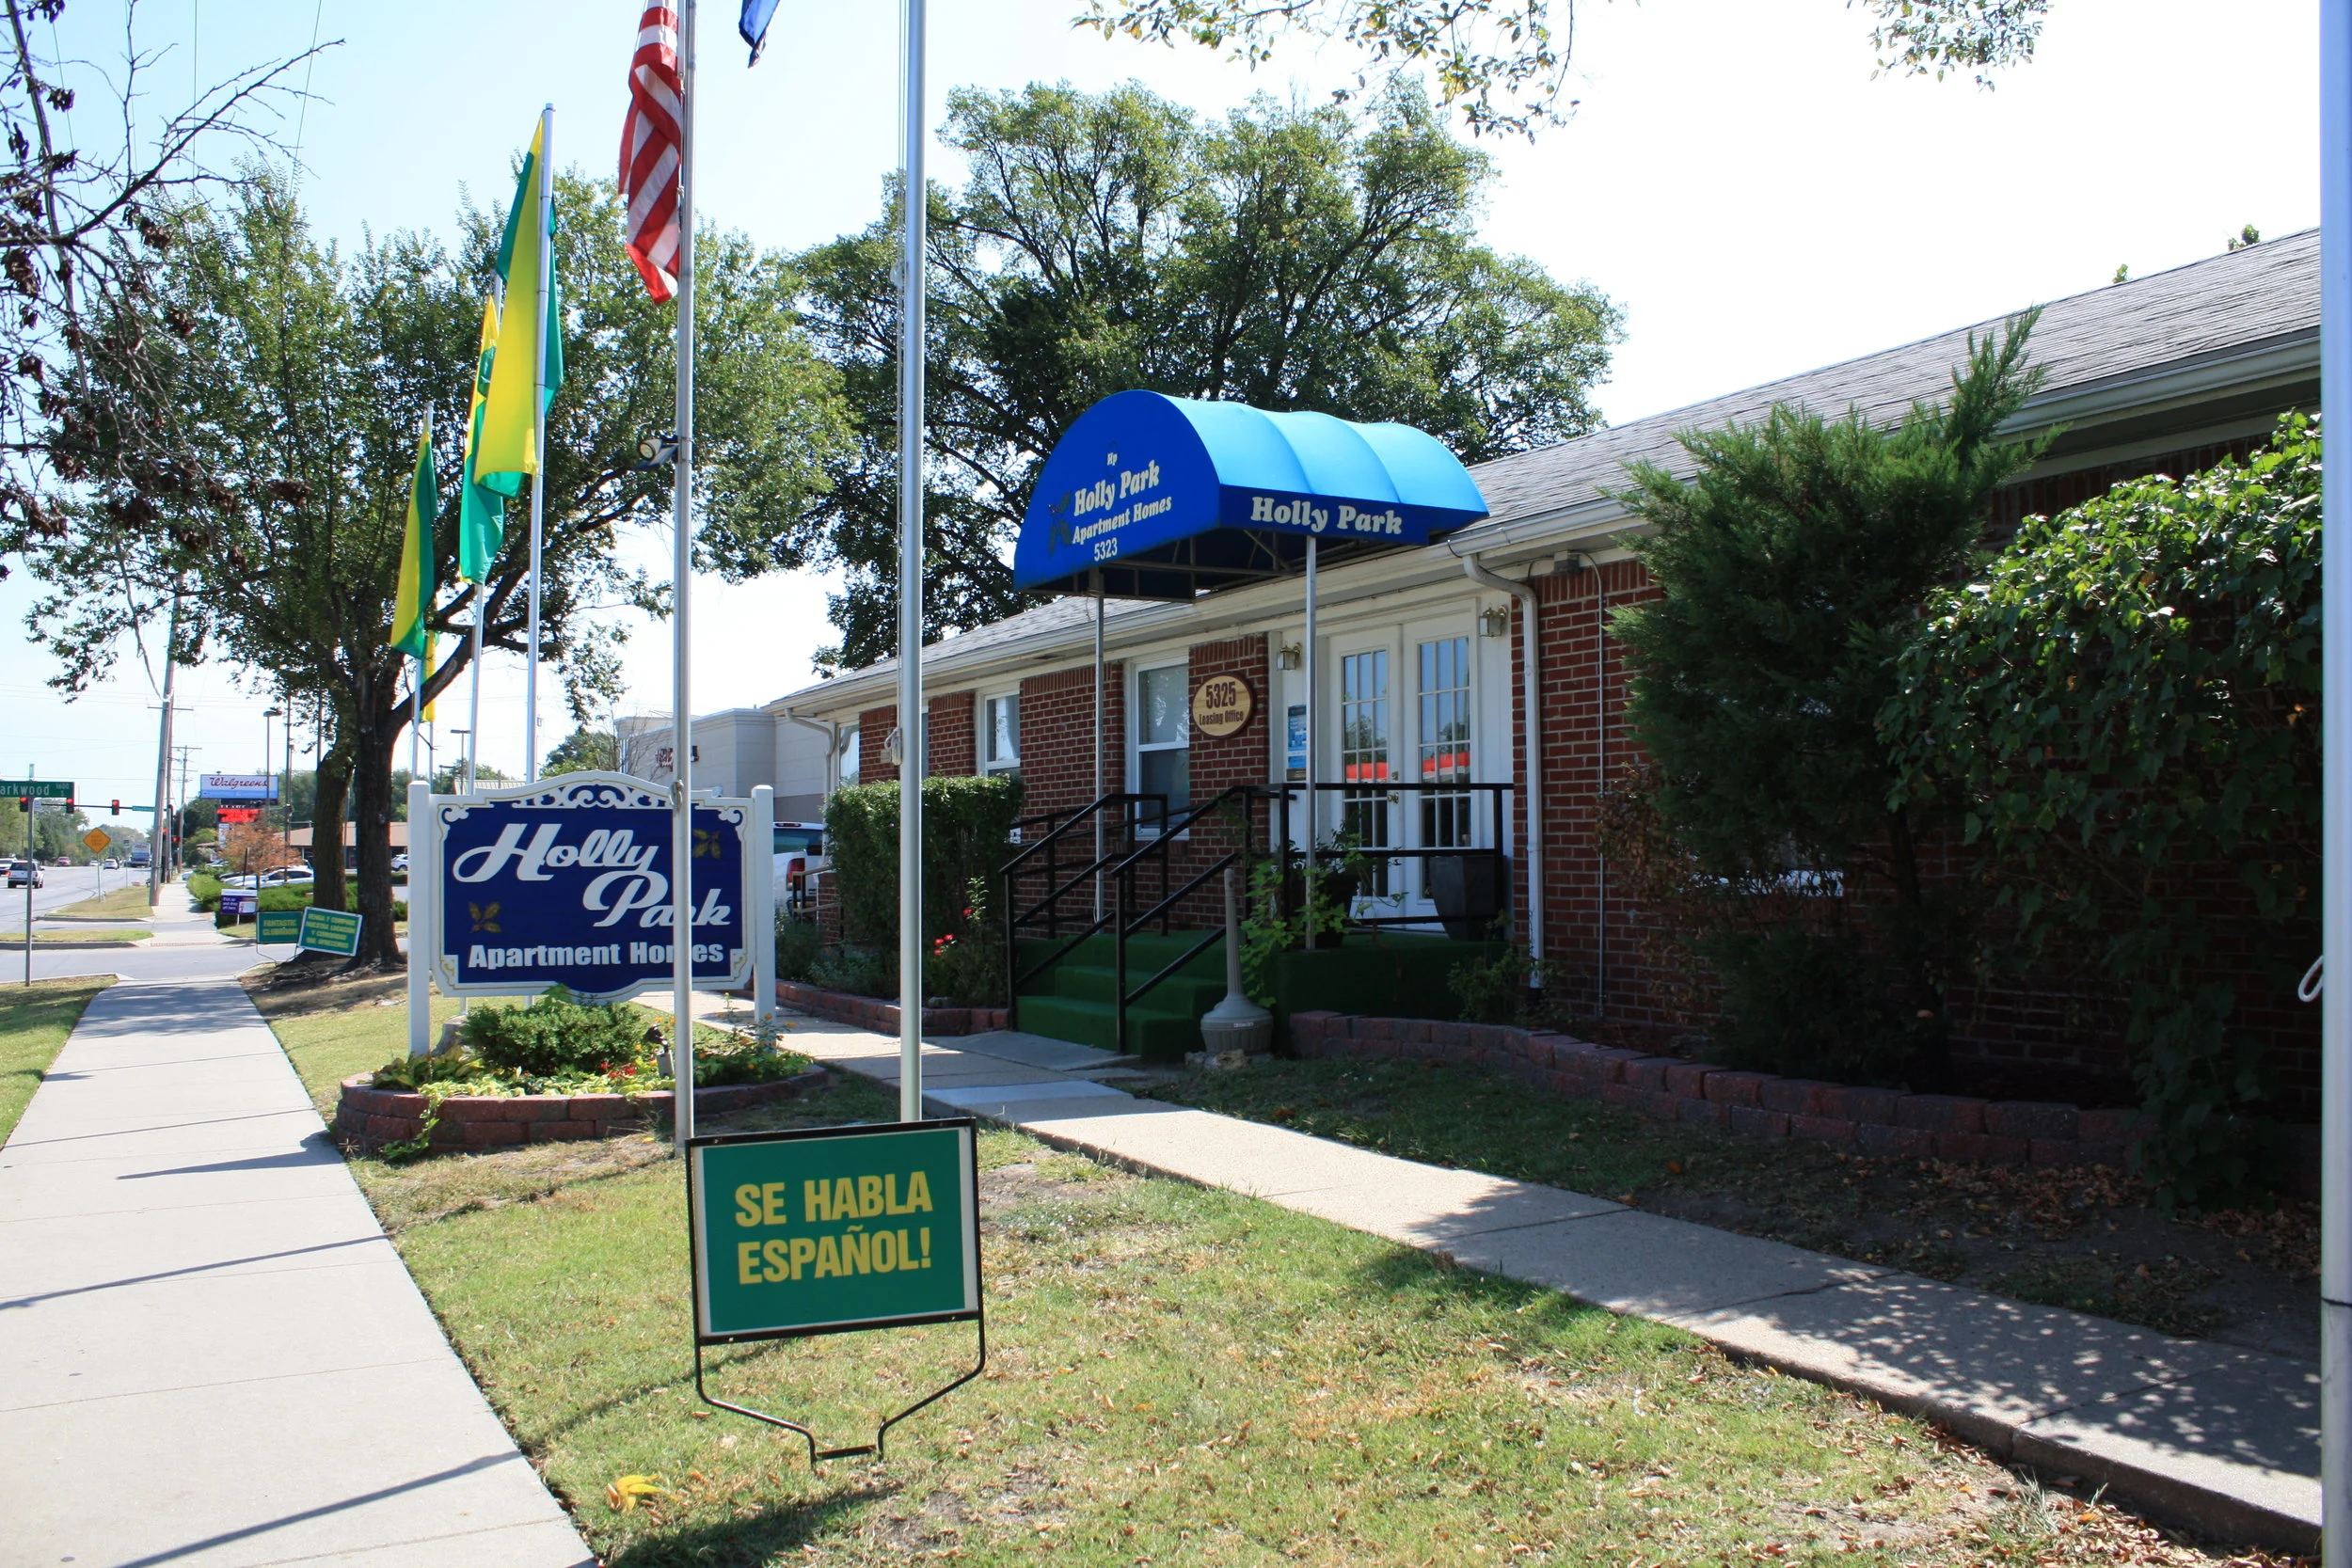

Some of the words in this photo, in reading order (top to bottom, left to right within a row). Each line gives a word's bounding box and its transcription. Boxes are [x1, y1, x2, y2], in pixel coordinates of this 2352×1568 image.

[1073, 479, 1116, 517] Holly
[1119, 459, 1160, 499] Park
[1072, 508, 1131, 546] Apartment
[1133, 496, 1172, 523] Homes
[1250, 496, 1328, 533] Holly
[1336, 504, 1403, 535] Park
[1093, 537, 1118, 562] 5323
[1205, 681, 1237, 709] 5325
[1199, 712, 1224, 726] Leasing
[1224, 709, 1244, 723] Office
[209, 776, 269, 789] Walgreens
[452, 822, 660, 882] Holly
[582, 869, 732, 928] Pak
[468, 943, 622, 970] Apartment
[734, 1181, 787, 1227] SE
[803, 1170, 934, 1223] HABLA
[737, 1224, 932, 1285] ESPAÑOL!
